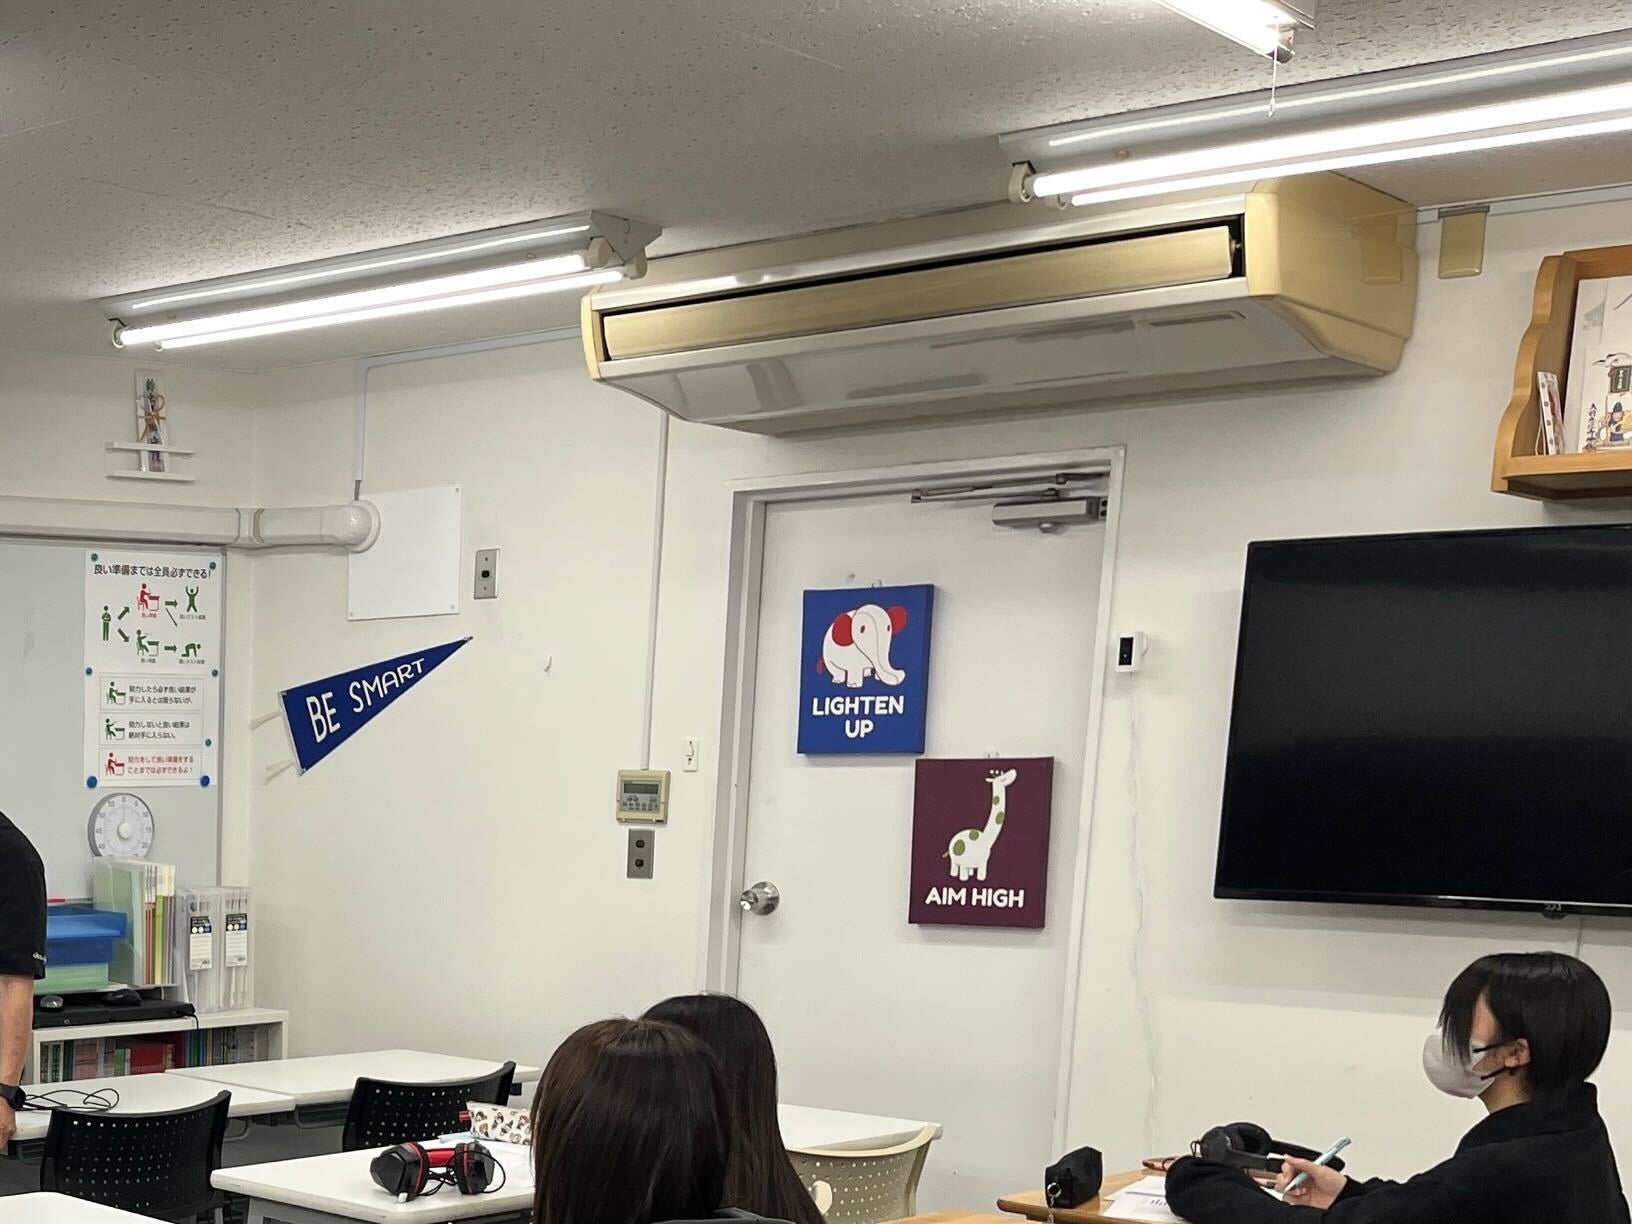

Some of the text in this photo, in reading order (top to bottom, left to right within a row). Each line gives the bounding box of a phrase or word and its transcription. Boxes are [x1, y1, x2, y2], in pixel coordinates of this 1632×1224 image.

[306, 657, 426, 744] BE SMART
[812, 695, 905, 716] LIGHTEN
[844, 719, 875, 738] UP
[924, 887, 1025, 908] AIM HIGH
